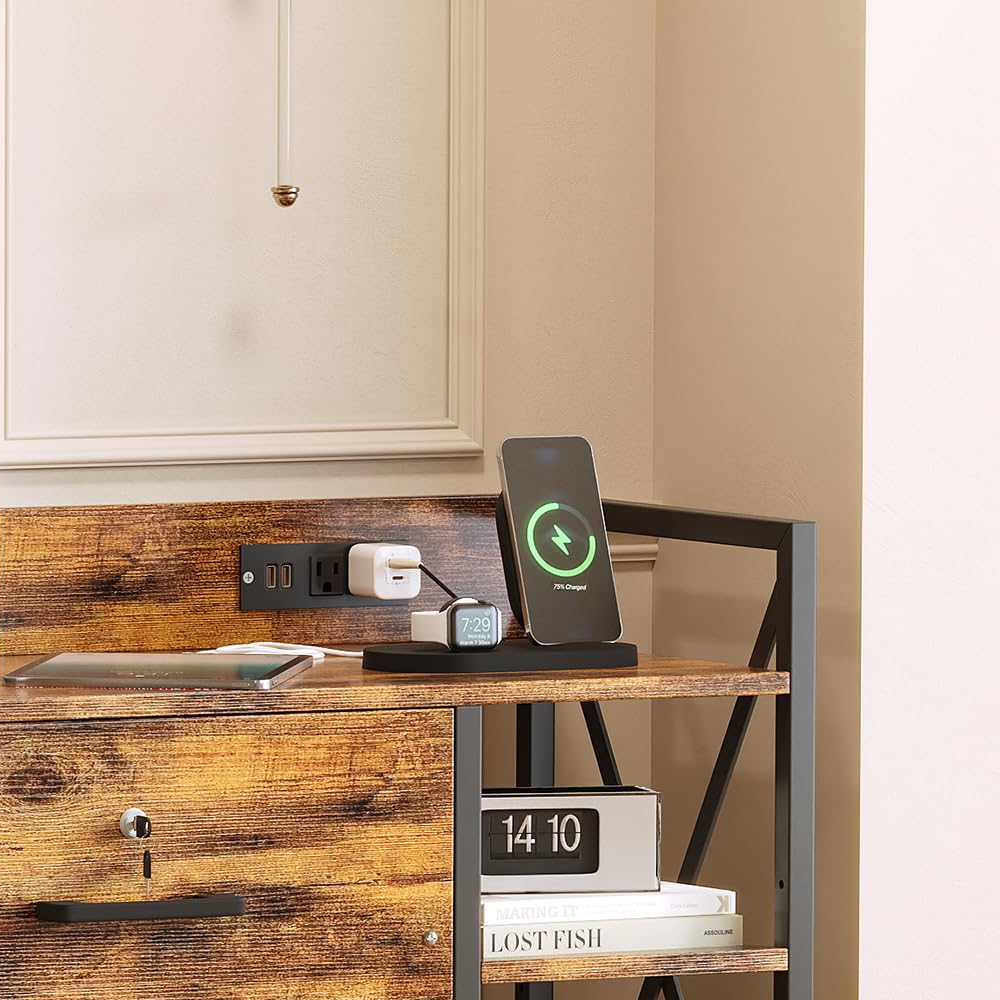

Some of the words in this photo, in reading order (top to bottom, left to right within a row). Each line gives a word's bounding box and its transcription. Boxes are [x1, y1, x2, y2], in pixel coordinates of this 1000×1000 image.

[553, 583, 565, 591] 75%
[565, 583, 587, 591] Charged
[461, 617, 491, 632] 7:29
[502, 814, 536, 853] 14
[547, 814, 581, 853] 10
[495, 905, 560, 921] MAKING
[563, 904, 579, 918] IT
[491, 931, 547, 953] LOST
[554, 928, 601, 950] FISH
